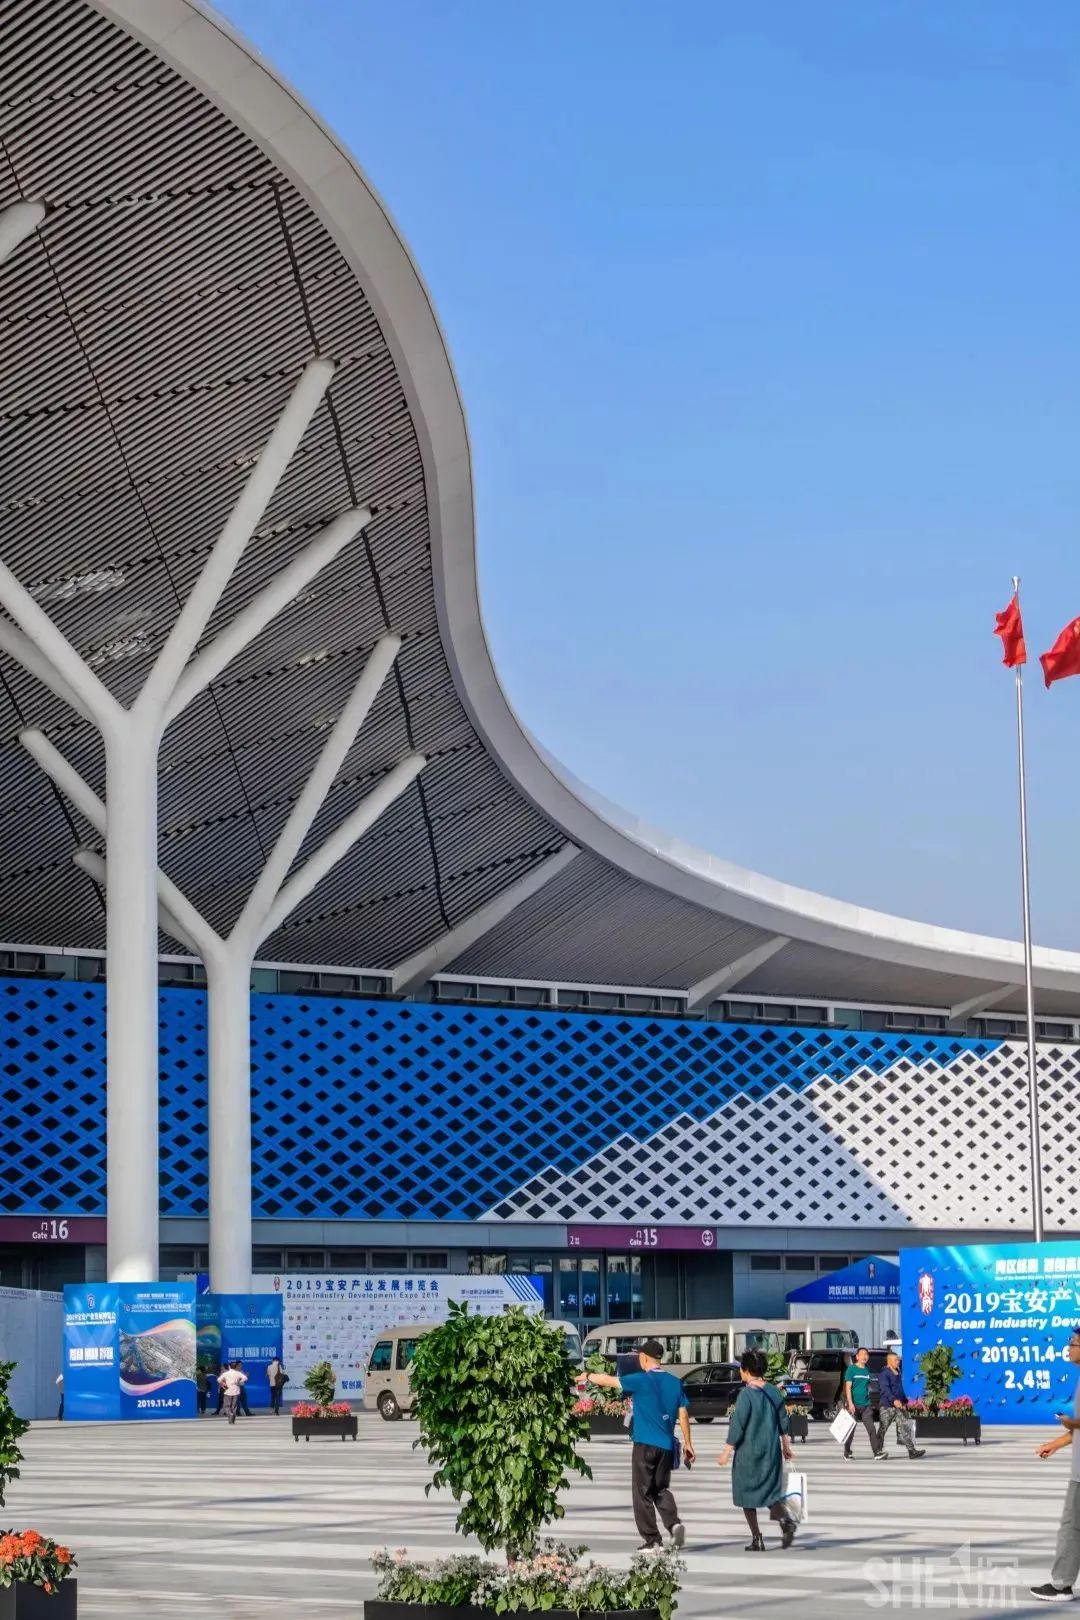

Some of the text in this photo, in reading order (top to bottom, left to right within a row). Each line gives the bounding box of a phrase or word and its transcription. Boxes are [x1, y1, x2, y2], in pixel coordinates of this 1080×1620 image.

[32, 1220, 69, 1239] Gate 16
[629, 1228, 658, 1246] Gate 15
[286, 1280, 439, 1291] 2019宝安产业发展博览会
[944, 1318, 986, 1330] Baoan
[989, 1316, 1048, 1330] Industry
[137, 1398, 181, 1408] 2019.11.4-6
